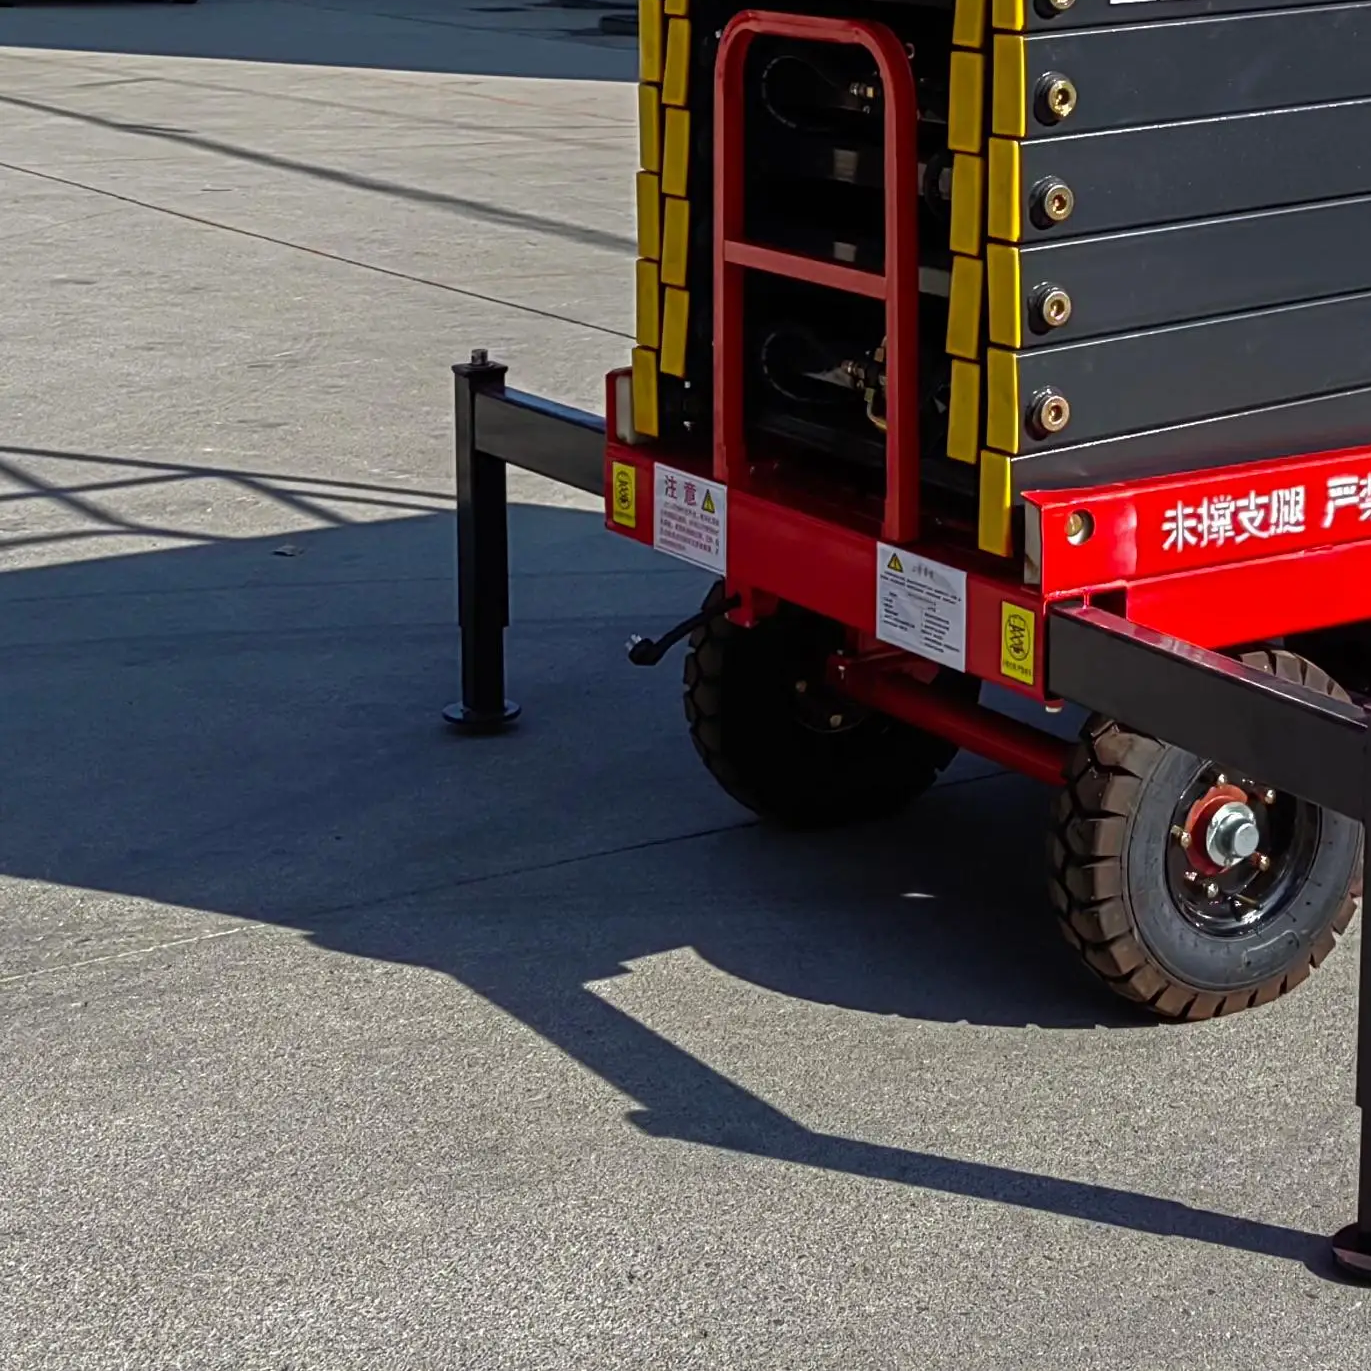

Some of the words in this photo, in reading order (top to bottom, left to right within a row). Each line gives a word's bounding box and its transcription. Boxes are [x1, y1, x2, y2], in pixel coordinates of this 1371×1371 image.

[664, 474, 697, 506] 注意
[1161, 485, 1306, 553] 未撑支腿
